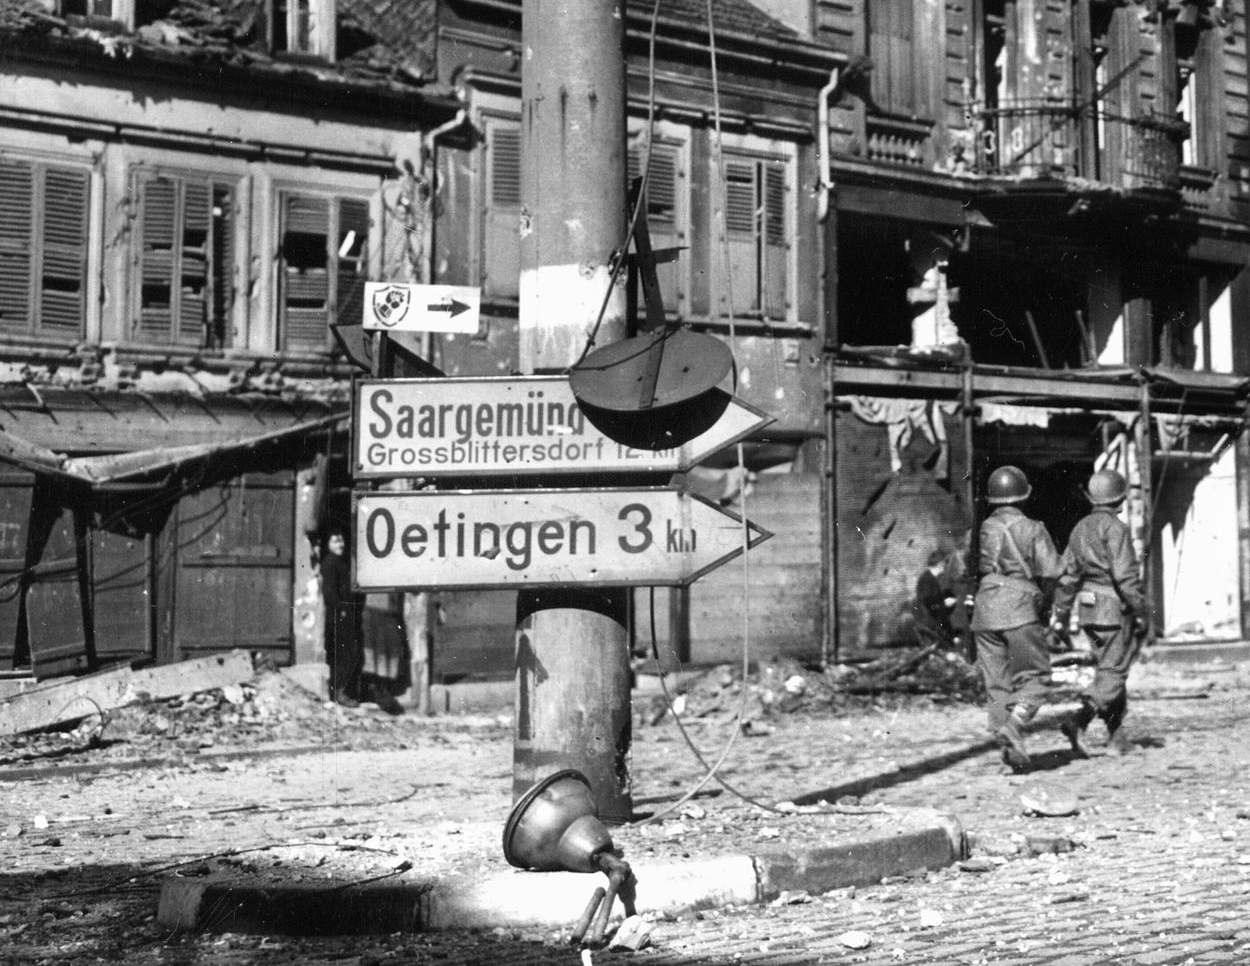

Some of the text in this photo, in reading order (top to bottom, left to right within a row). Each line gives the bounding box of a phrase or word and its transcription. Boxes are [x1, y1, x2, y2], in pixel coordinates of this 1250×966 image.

[370, 389, 584, 444] Saargemünd
[367, 437, 604, 465] Grossblittersdorf
[365, 502, 697, 571] Oetingen 3 km
